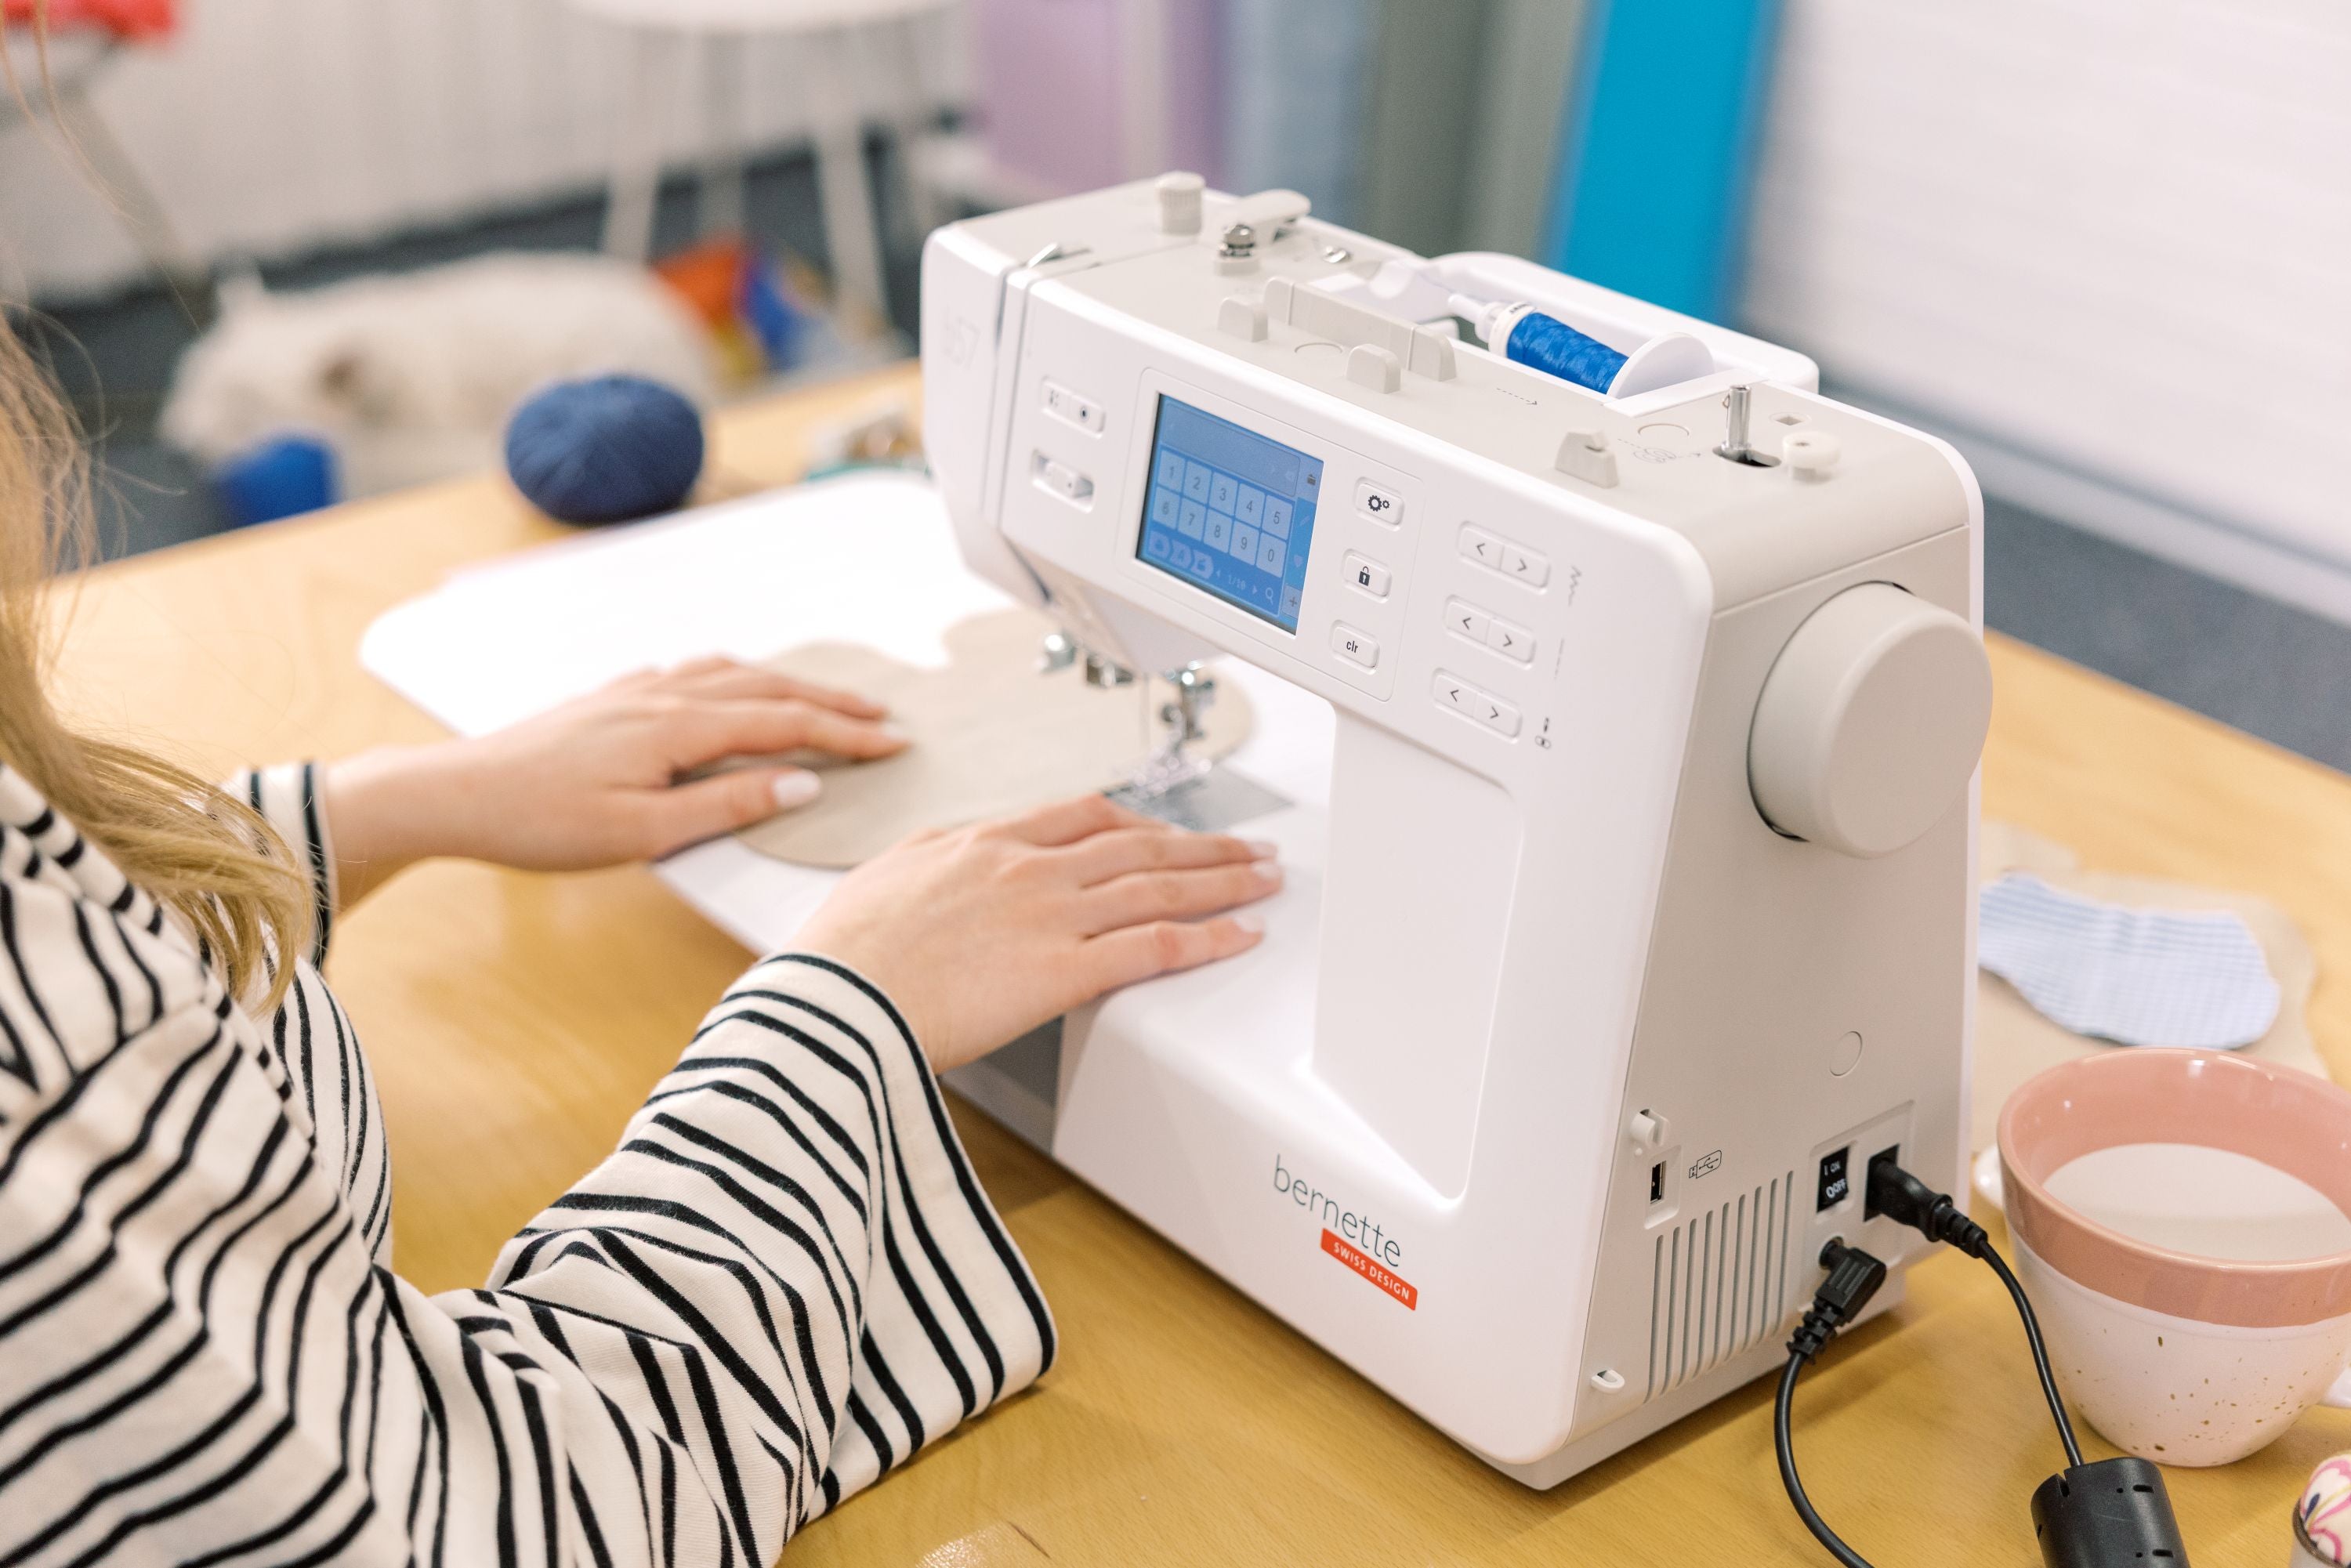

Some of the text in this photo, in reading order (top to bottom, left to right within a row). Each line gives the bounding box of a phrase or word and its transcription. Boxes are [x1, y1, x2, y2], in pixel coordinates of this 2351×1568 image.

[1193, 476, 1201, 491] 2
[1219, 487, 1227, 501] 3
[1246, 500, 1253, 513] 4
[1273, 511, 1281, 524] 5
[1161, 502, 1274, 562] 6 7 8 9 0
[1346, 640, 1359, 653] clr
[1273, 1153, 1400, 1267] bernette
[1333, 1241, 1410, 1301] SWISS DESIGN
